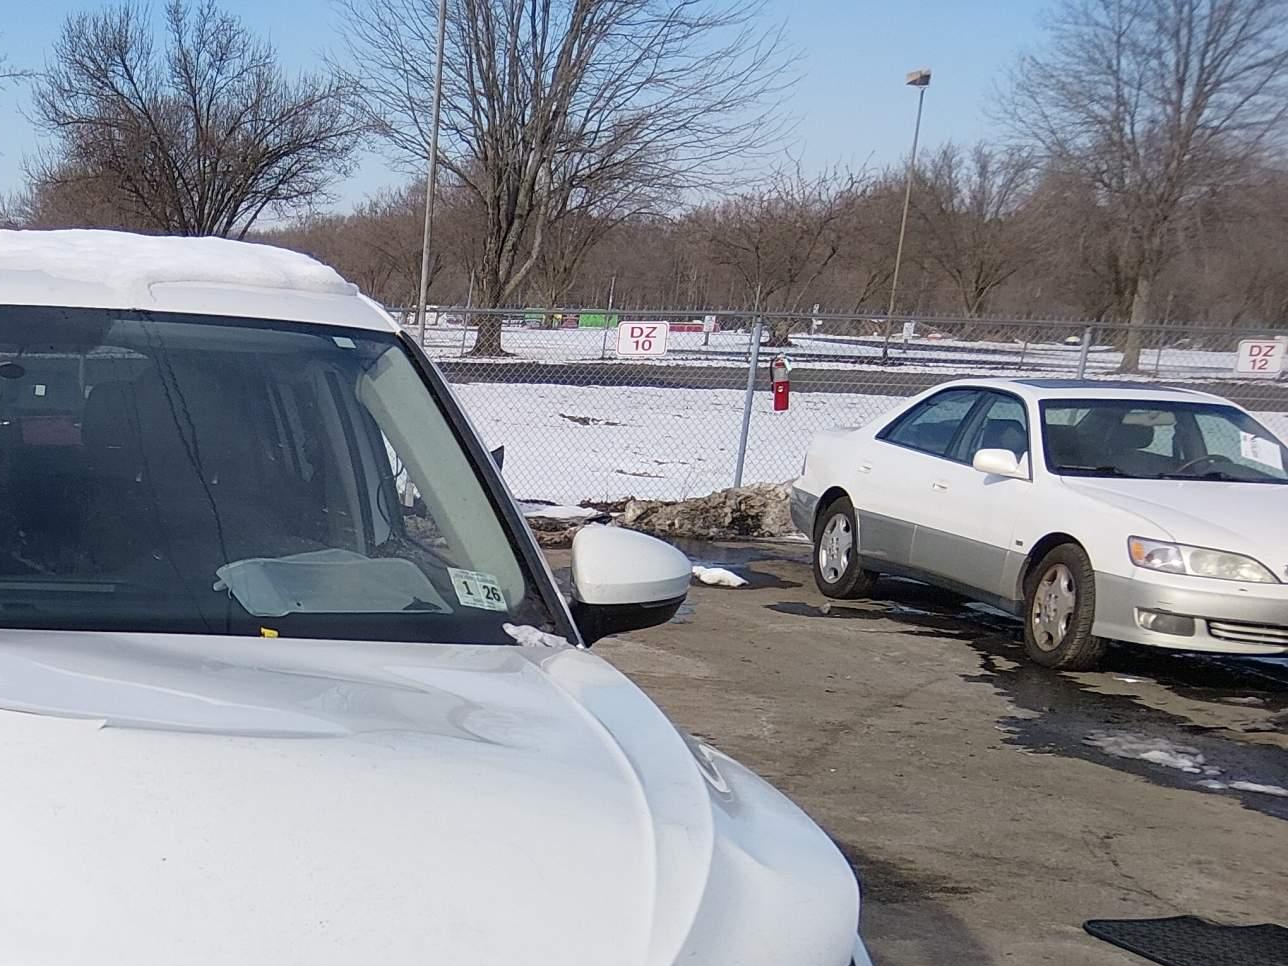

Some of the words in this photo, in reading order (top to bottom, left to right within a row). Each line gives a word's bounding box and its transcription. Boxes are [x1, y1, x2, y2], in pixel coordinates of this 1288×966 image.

[630, 326, 658, 339] DZ
[632, 339, 652, 352] 10
[1248, 345, 1276, 357] DZ
[1249, 358, 1269, 370] 12
[462, 580, 474, 596] 1
[482, 585, 501, 602] 26
